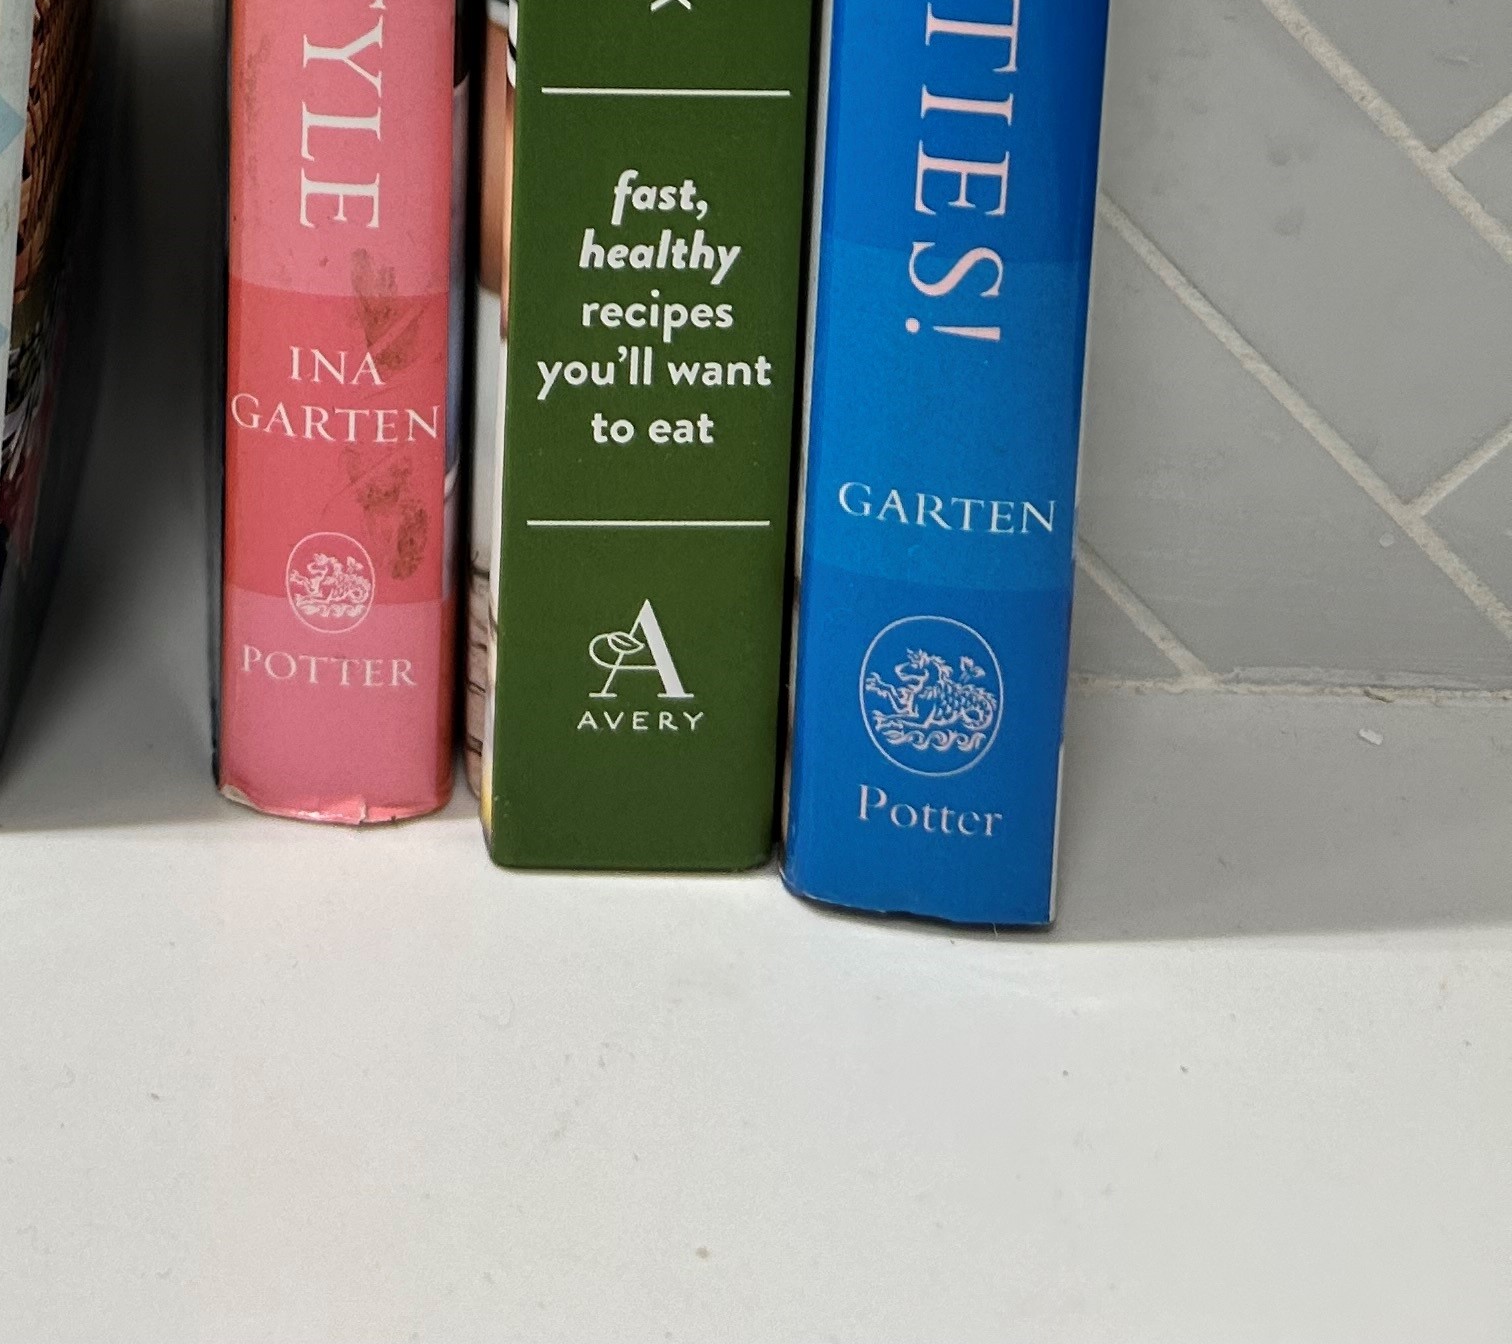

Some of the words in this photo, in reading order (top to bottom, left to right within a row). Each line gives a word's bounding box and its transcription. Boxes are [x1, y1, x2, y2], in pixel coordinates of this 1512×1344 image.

[611, 169, 710, 225] fast,
[578, 229, 742, 283] healthy
[581, 289, 734, 347] recipes
[289, 346, 386, 386] INA
[668, 354, 773, 388] want
[230, 392, 440, 443] GARTEN
[591, 413, 636, 444] to
[648, 413, 715, 445] eat
[837, 482, 1056, 534] GARTEN
[240, 643, 418, 688] POTTER
[576, 710, 705, 731] AVERY
[857, 784, 1004, 839] Potter
